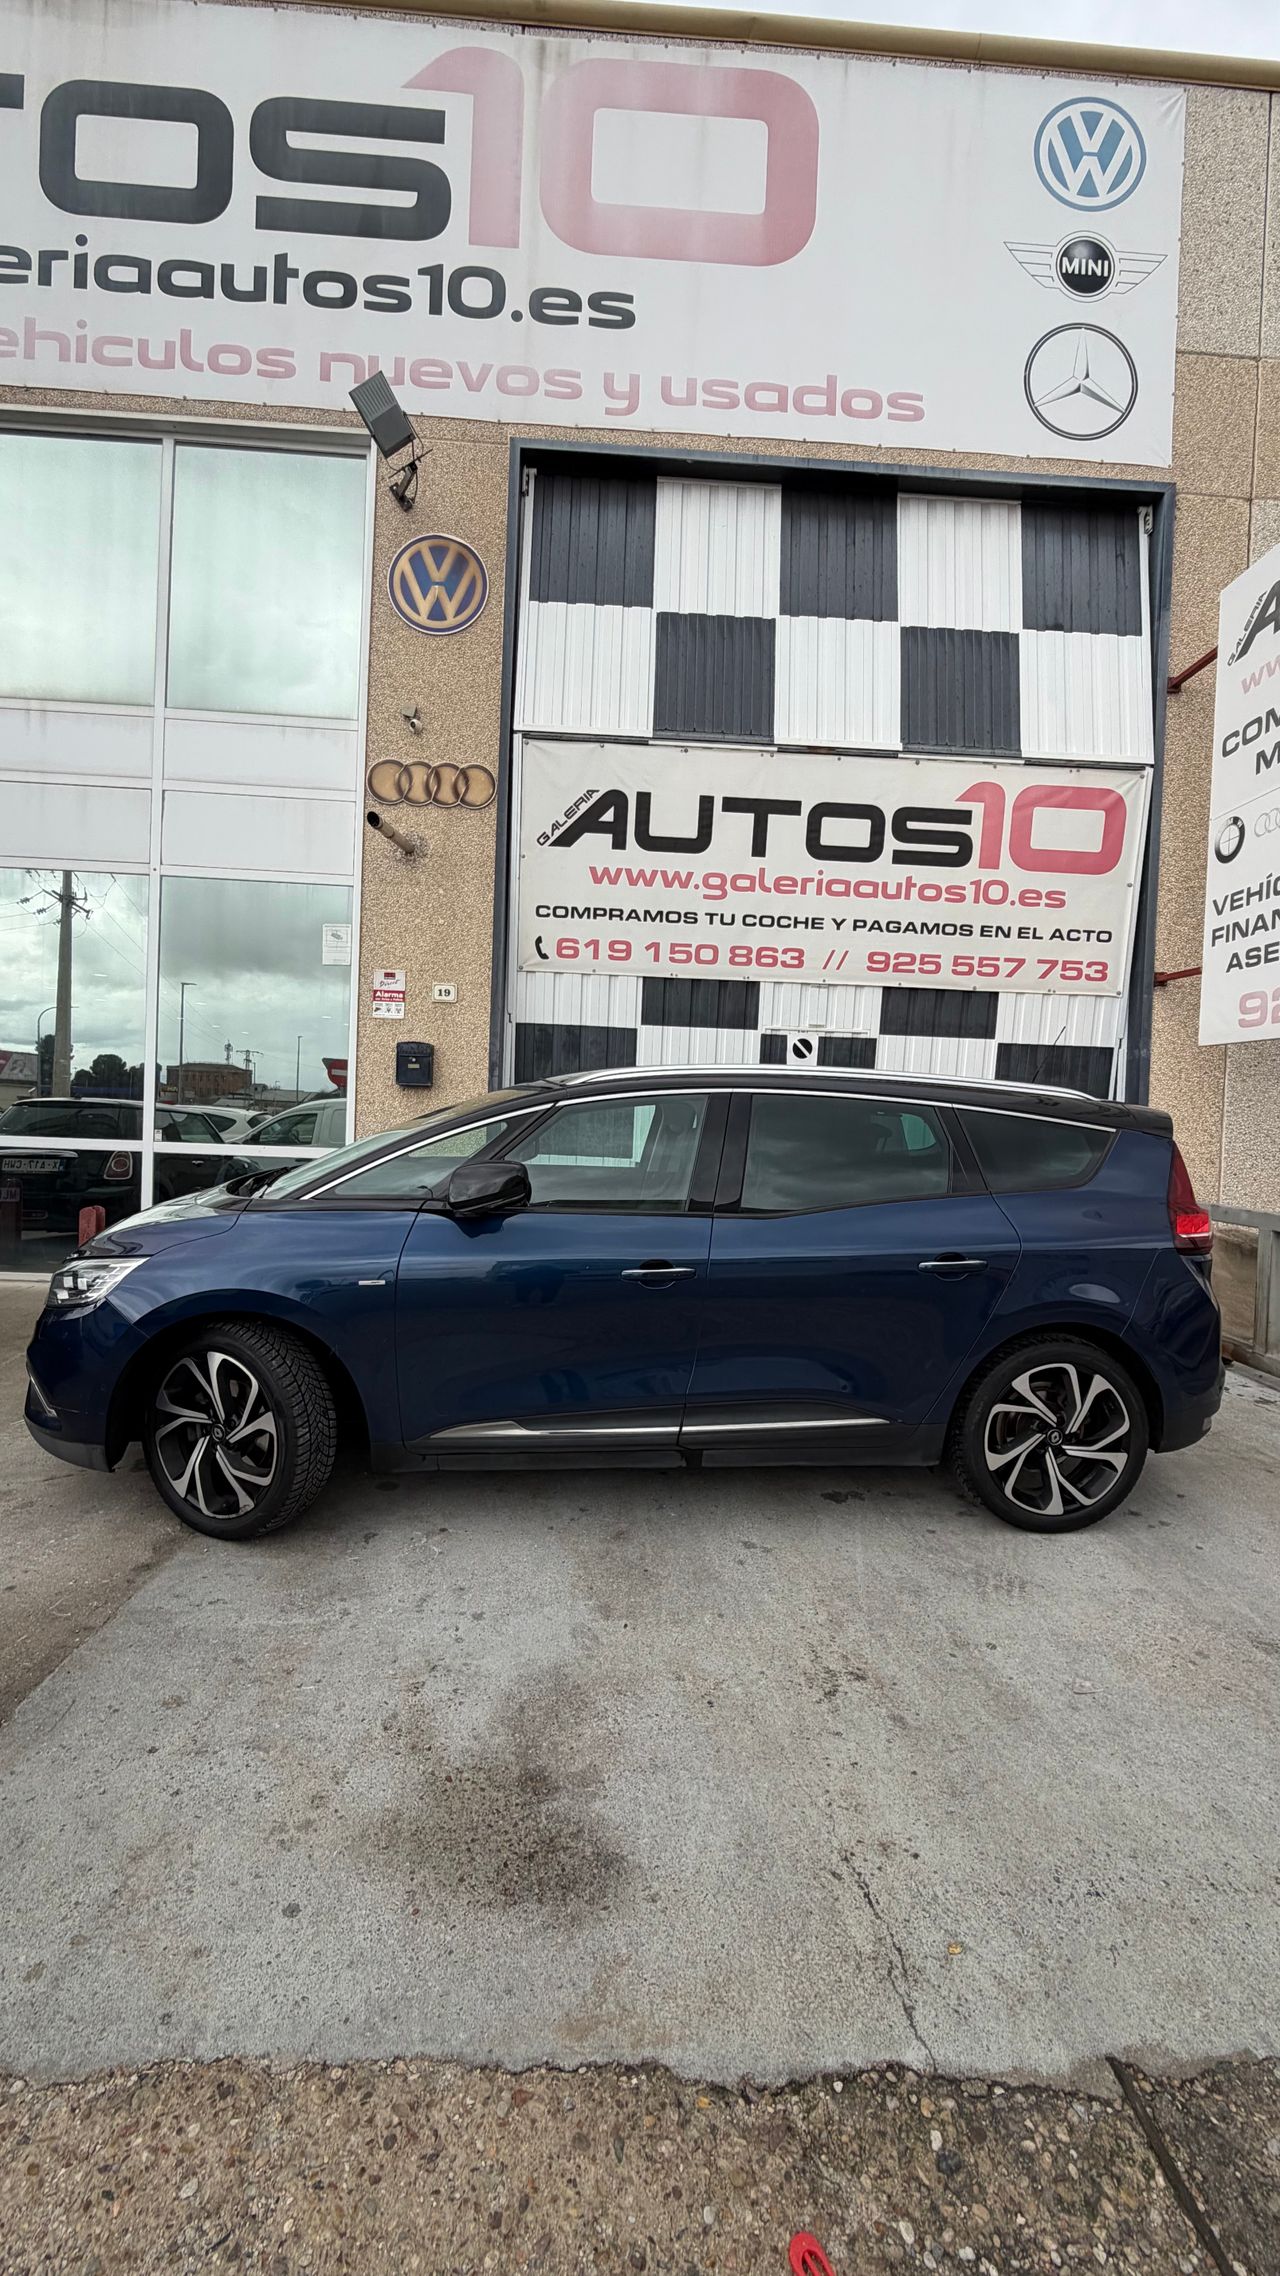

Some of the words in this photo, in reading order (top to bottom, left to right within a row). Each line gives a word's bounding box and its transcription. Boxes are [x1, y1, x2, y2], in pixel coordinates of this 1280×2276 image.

[0, 46, 819, 267] OS10
[1061, 256, 1109, 277] MINI
[319, 351, 583, 400] nuevos
[603, 371, 645, 416] y
[660, 375, 925, 423] usados
[536, 789, 600, 847] GALERIA
[548, 781, 1127, 876] AUTOS10
[588, 865, 1068, 910] www.galeriaautos10.es
[535, 904, 699, 925] COMPRAMOS
[704, 912, 736, 926] TU
[741, 914, 825, 930] COCHE
[831, 918, 847, 931] Y
[852, 919, 974, 937] PAGAMOS
[979, 925, 1012, 939] EN
[1016, 926, 1044, 940] EL
[1049, 928, 1113, 943] ACTO
[555, 937, 633, 961] 619
[644, 940, 720, 966] 150
[728, 945, 805, 969] 863
[866, 950, 943, 975] 925
[951, 955, 1026, 978] 557
[1036, 958, 1109, 983] 753
[437, 988, 451, 997] 19
